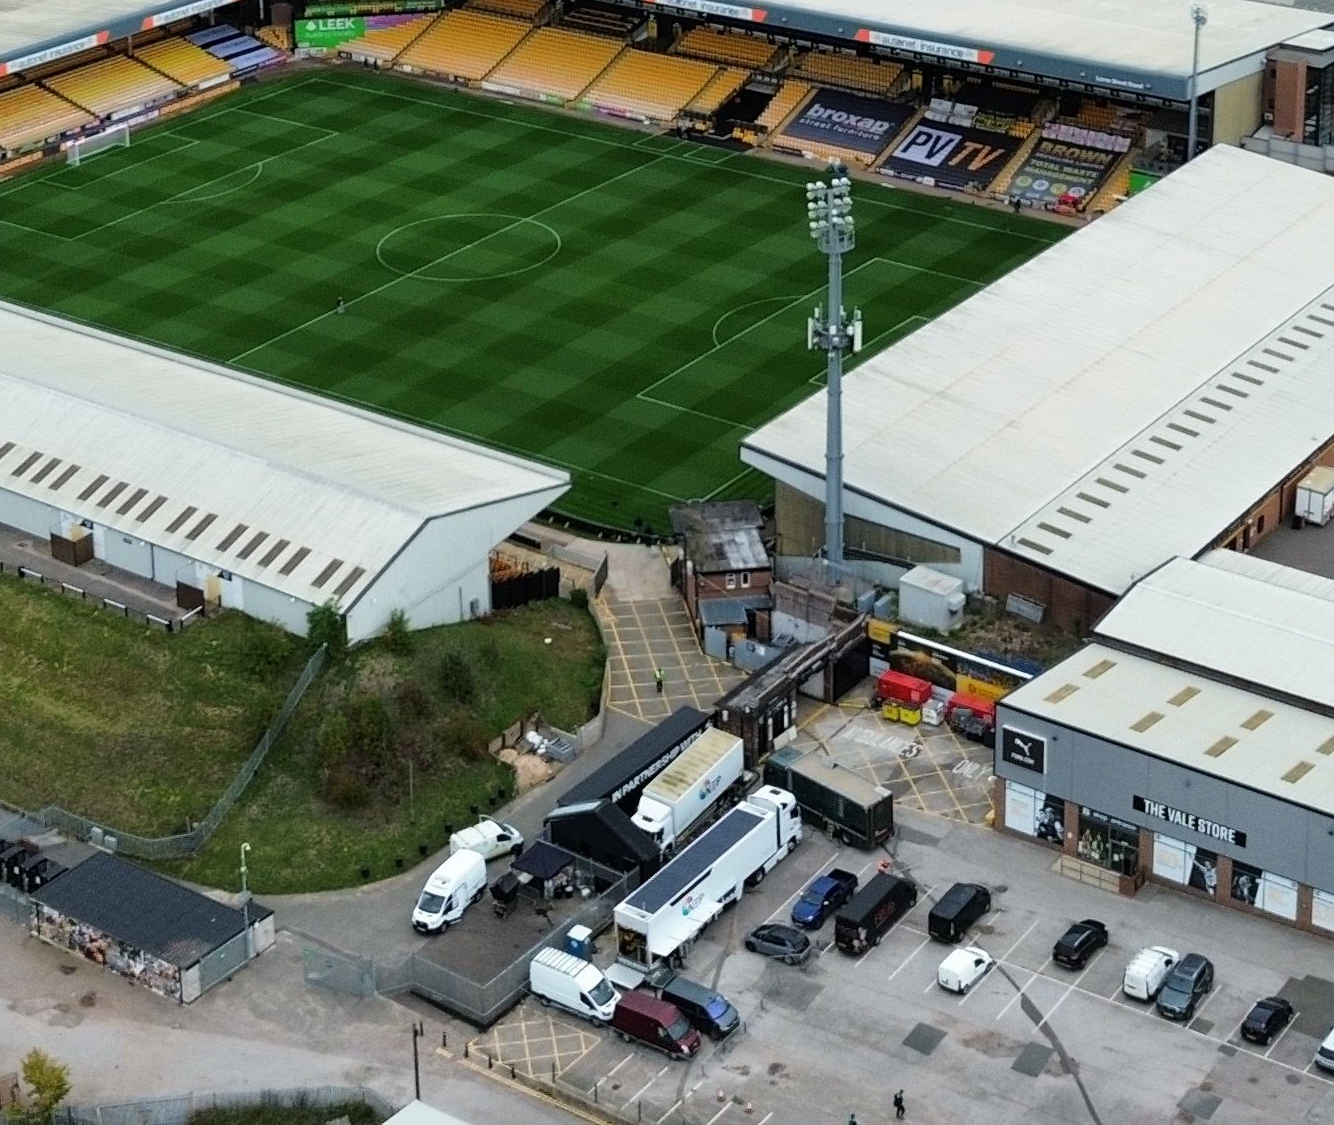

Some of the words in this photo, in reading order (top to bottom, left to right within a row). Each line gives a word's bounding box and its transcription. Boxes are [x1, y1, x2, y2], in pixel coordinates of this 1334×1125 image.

[319, 18, 355, 31] LEEK
[920, 40, 965, 58] insurance
[807, 103, 890, 135] broxap
[901, 130, 956, 160] PV
[948, 140, 1005, 171] TV
[1039, 141, 1114, 164] BROWN
[611, 788, 623, 804] IN
[622, 745, 681, 796] PARTNERSHIP
[1143, 798, 1167, 820] THE
[1167, 806, 1197, 830] VALE
[1197, 818, 1237, 844] STORE
